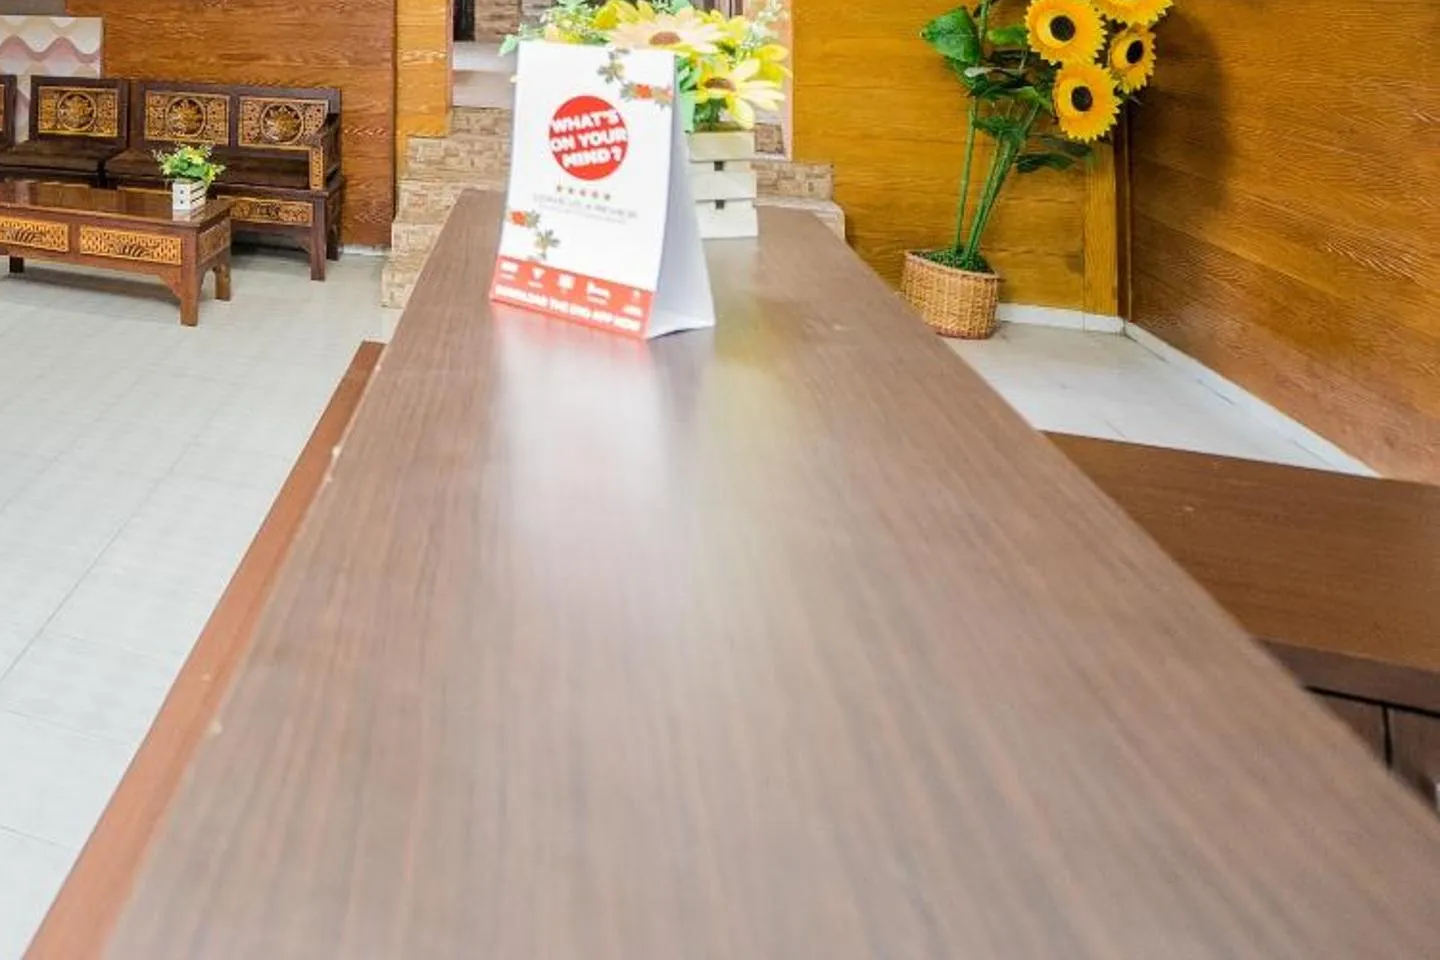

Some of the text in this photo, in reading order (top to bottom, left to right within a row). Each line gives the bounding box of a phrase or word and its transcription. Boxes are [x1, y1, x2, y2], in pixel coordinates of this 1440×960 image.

[553, 107, 620, 134] WHAT'S
[549, 127, 628, 152] ON YOUR
